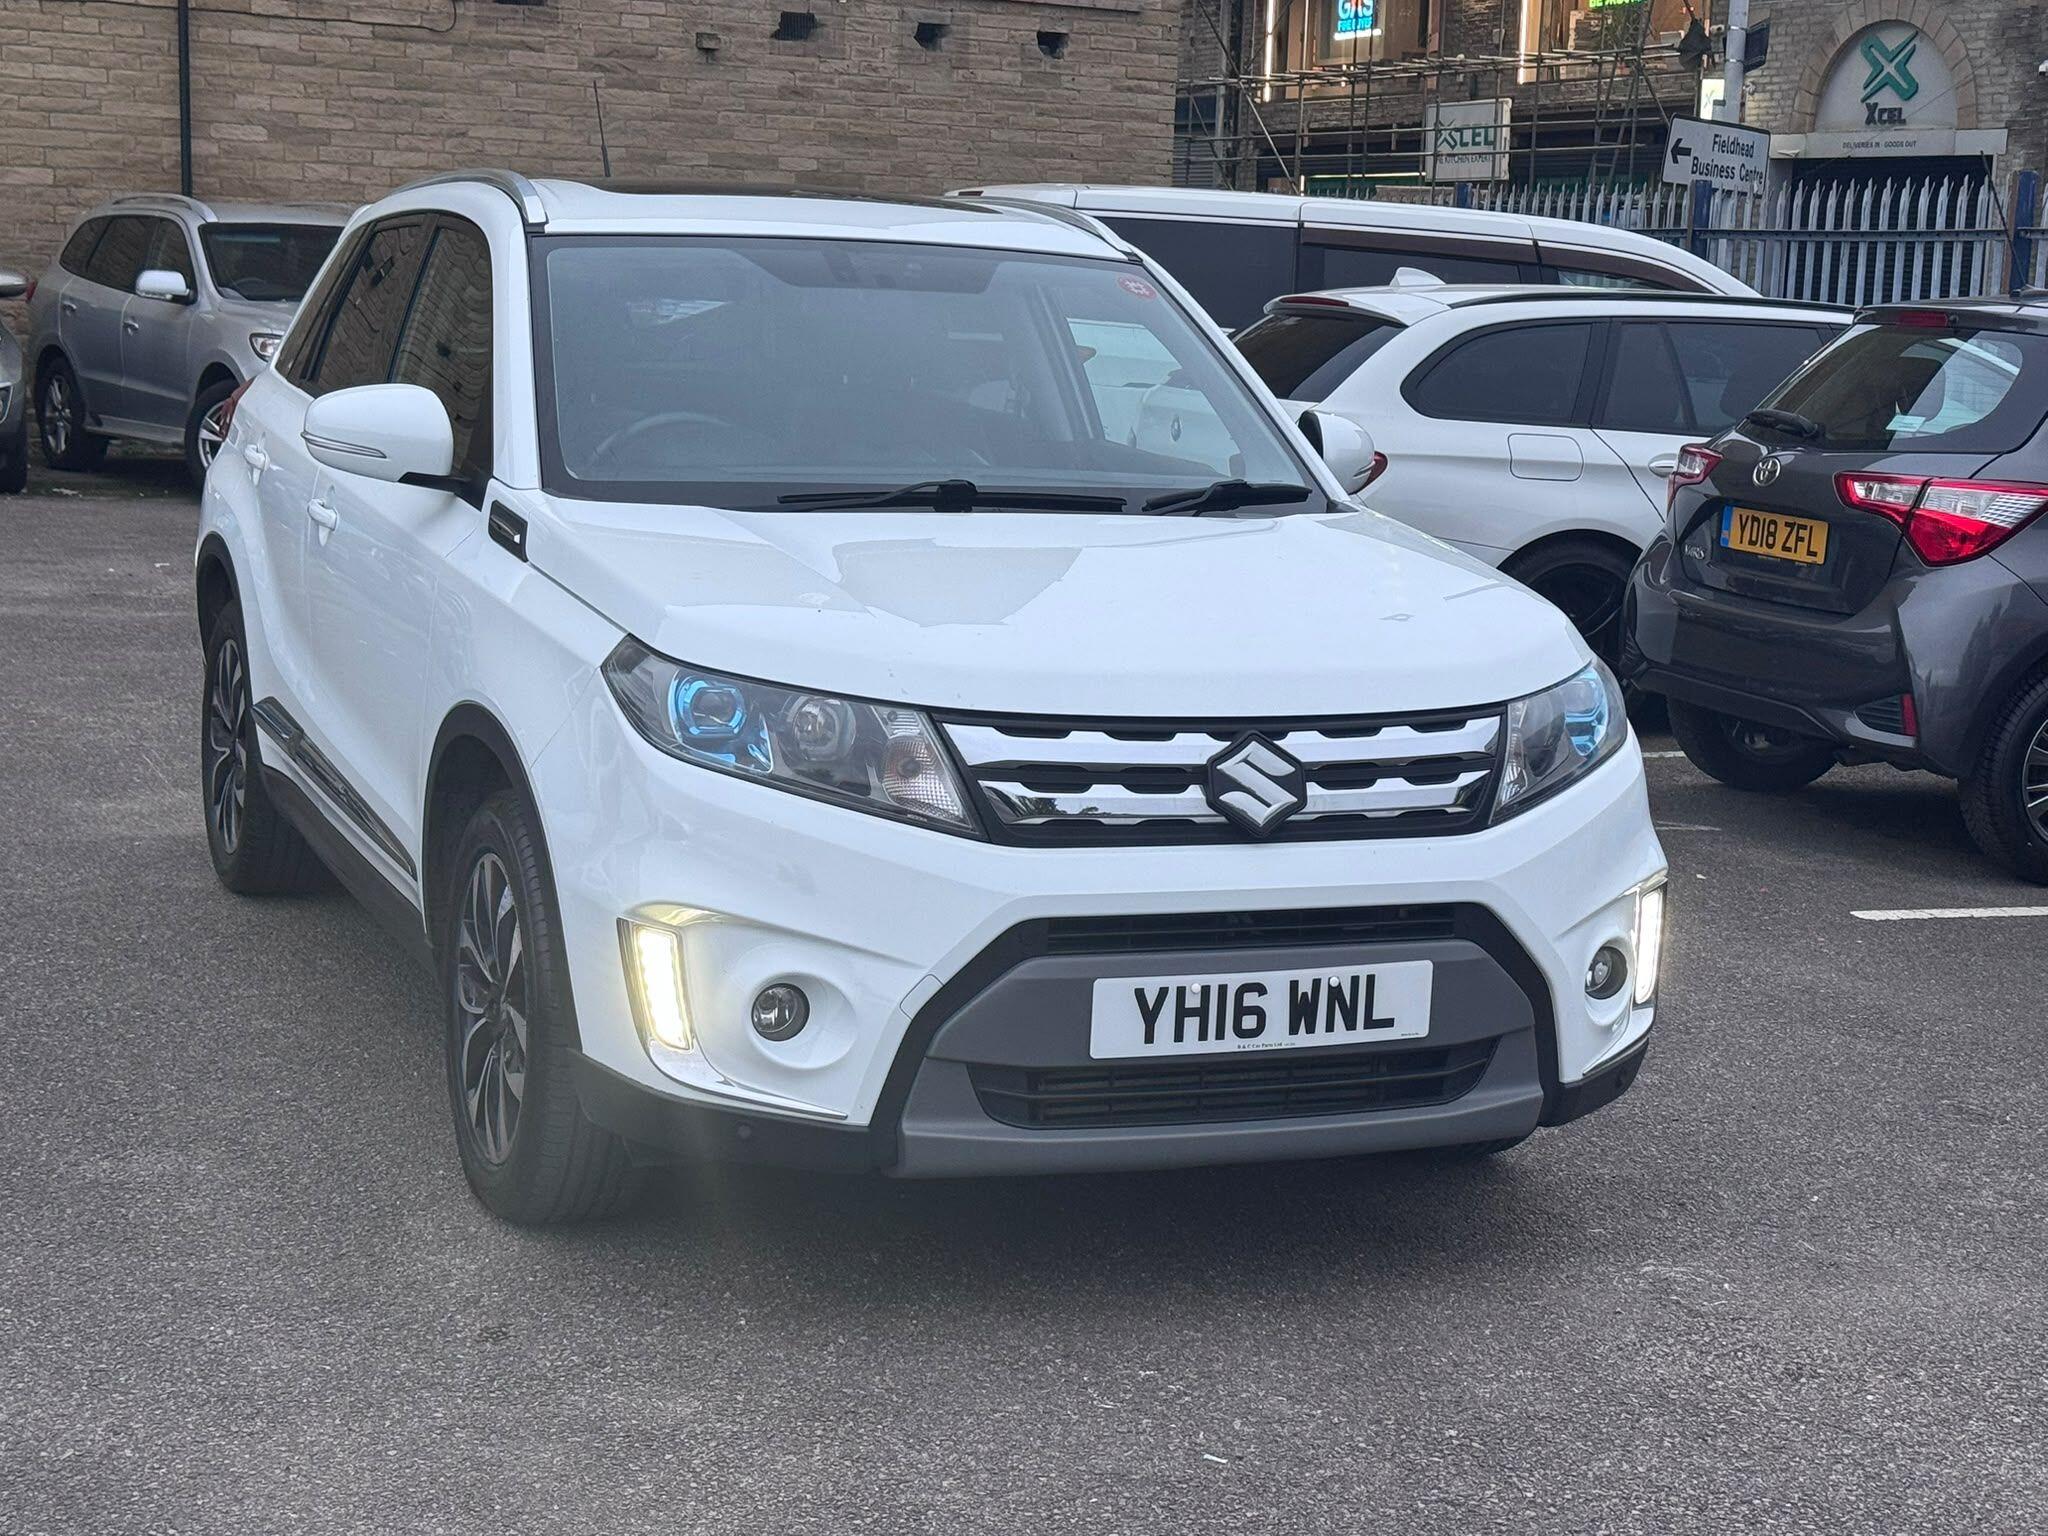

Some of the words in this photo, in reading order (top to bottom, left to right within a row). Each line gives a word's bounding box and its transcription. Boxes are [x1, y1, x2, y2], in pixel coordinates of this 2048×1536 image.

[1712, 134, 1755, 158] Fieldhead
[1904, 140, 1917, 149] OUT
[1691, 156, 1736, 180] Business
[1739, 163, 1764, 185] Centre
[1738, 513, 1778, 550] YD18
[1781, 521, 1818, 558] ZFL
[1134, 982, 1268, 1045] YH16
[1289, 974, 1396, 1036] WNL
